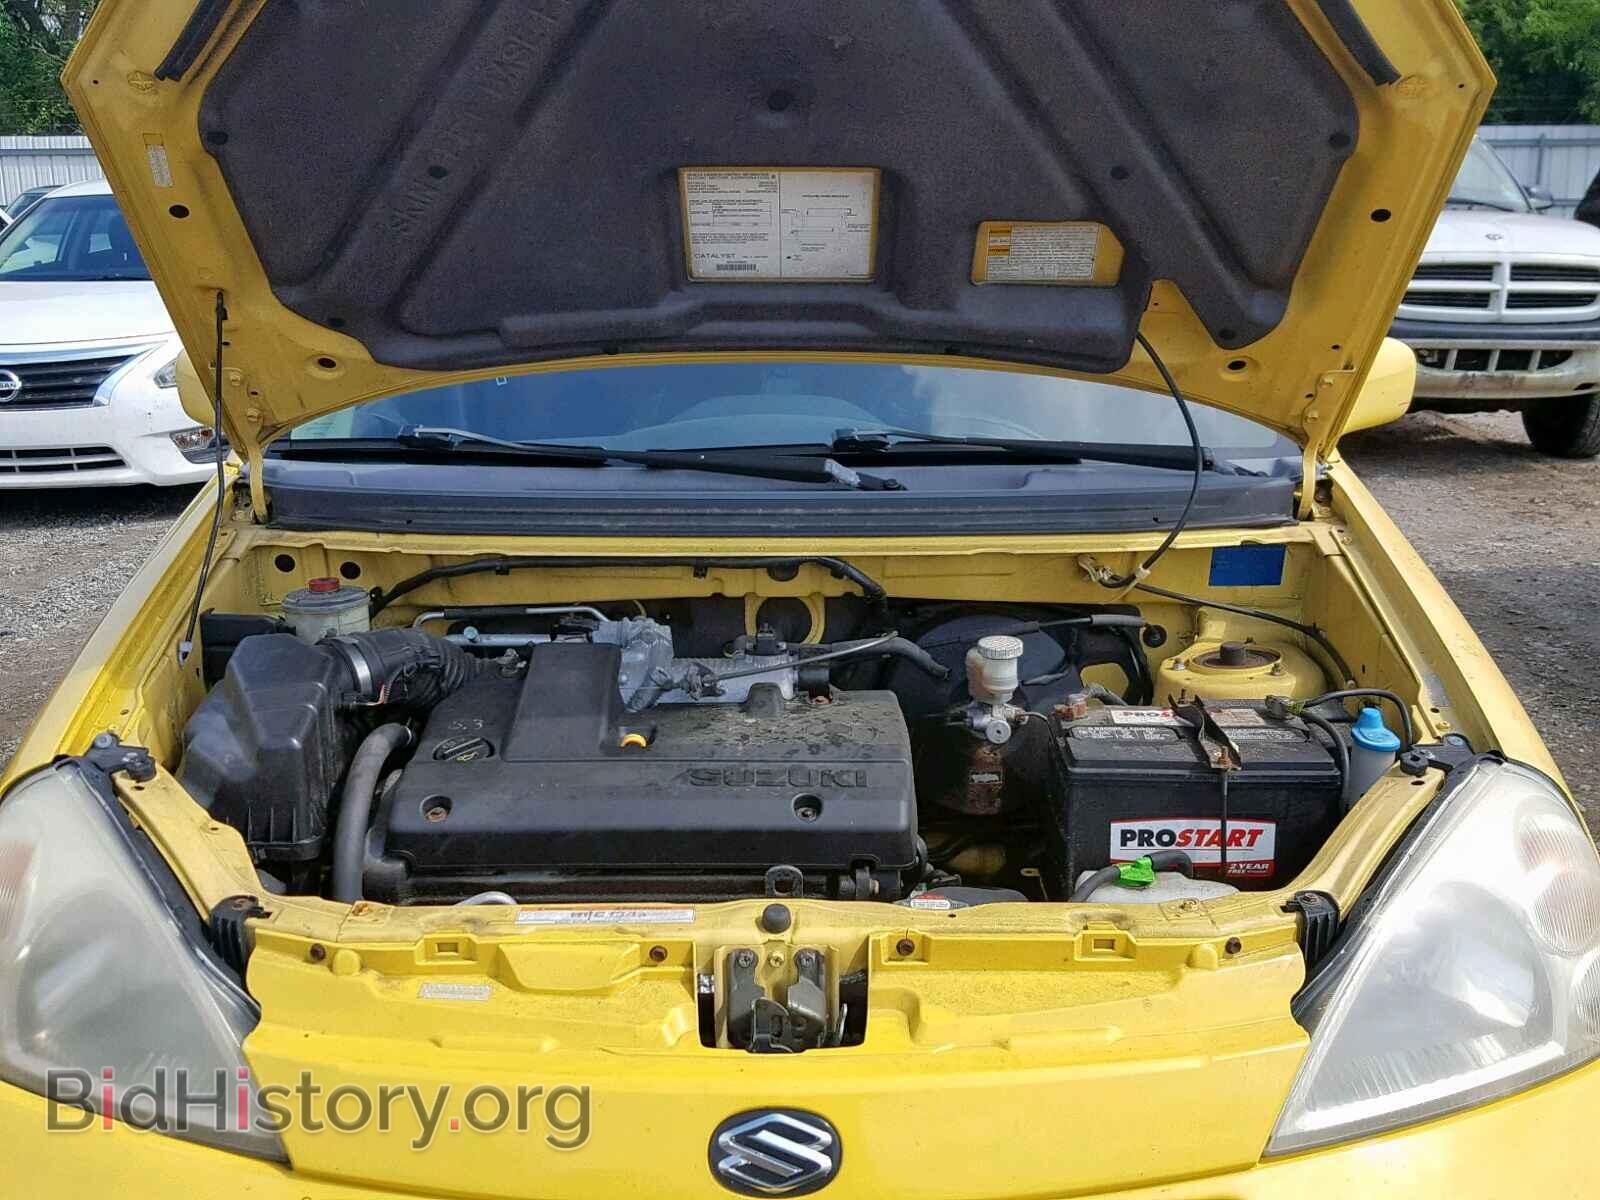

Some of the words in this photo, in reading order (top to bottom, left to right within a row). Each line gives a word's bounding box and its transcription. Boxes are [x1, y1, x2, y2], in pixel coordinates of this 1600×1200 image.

[689, 768, 868, 787] SUZUKI
[1120, 829, 1265, 848] PROSTART
[1238, 862, 1270, 870] YEAR
